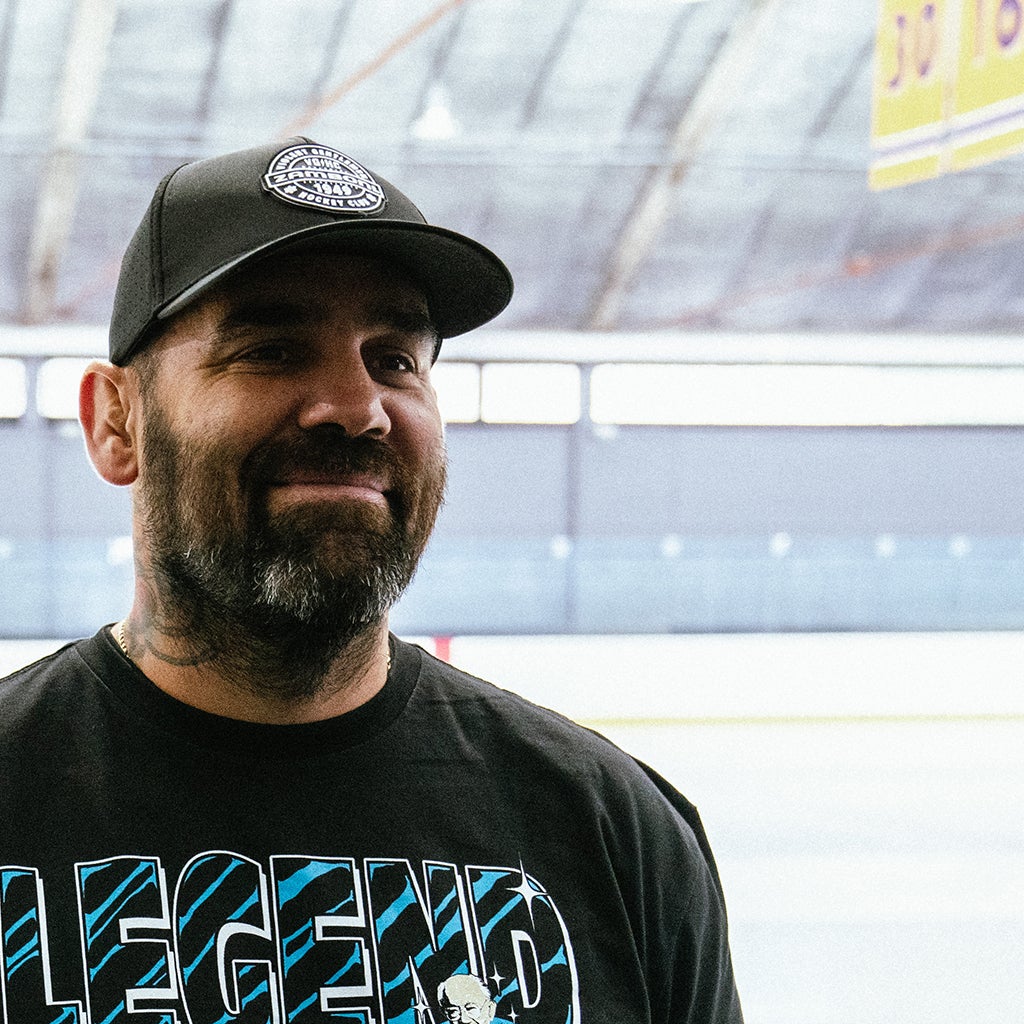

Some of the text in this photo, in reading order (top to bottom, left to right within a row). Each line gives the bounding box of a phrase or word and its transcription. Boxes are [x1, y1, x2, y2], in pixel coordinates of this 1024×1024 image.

[274, 170, 378, 194] ZAMBONI
[314, 183, 353, 196] 1949
[297, 191, 378, 208] HOCKEY CLUB
